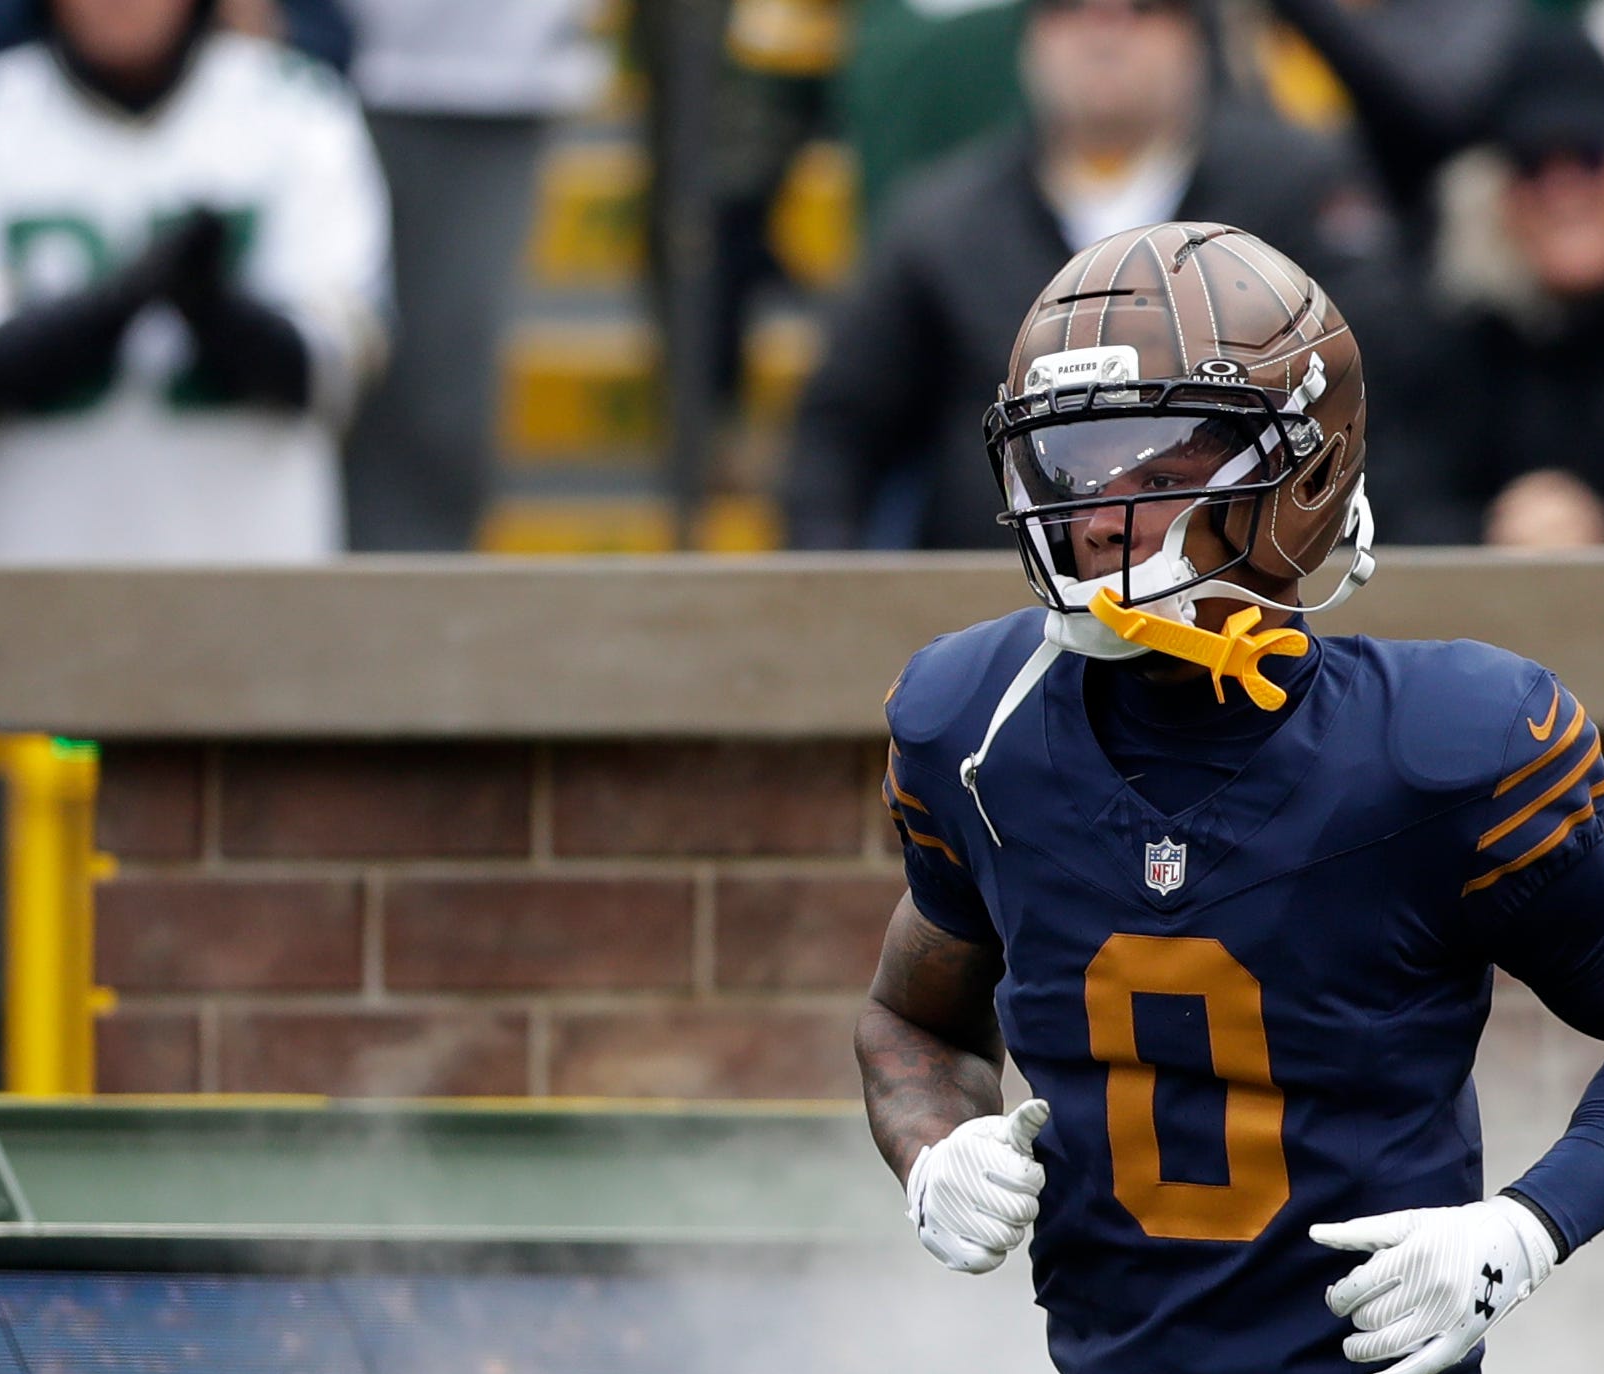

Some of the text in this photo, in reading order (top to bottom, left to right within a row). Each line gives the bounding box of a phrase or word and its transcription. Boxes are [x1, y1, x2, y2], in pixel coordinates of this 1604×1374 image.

[1058, 362, 1097, 374] PACKERS
[1151, 863, 1179, 884] NFL
[1084, 933, 1290, 1242] 0
